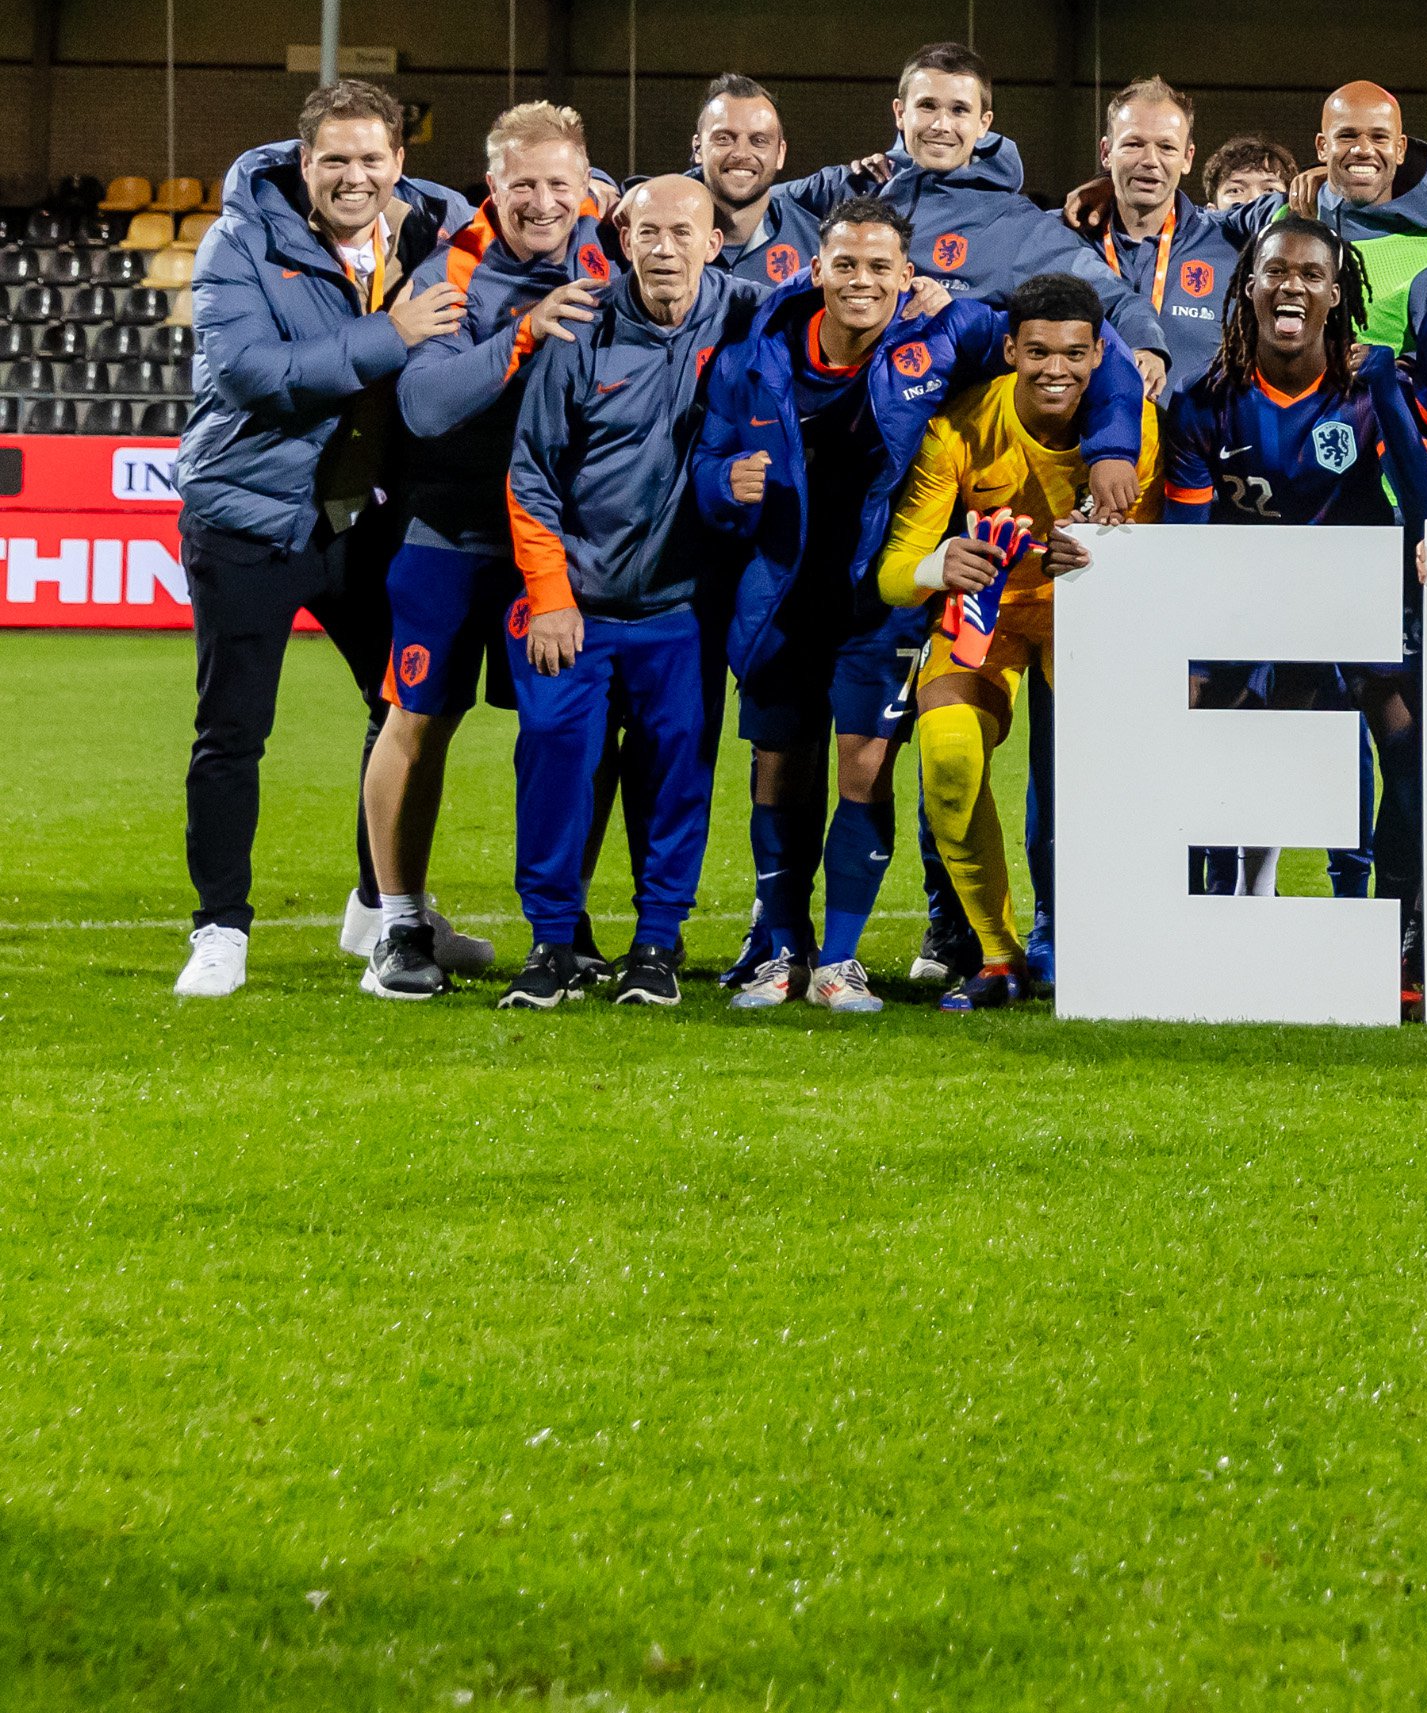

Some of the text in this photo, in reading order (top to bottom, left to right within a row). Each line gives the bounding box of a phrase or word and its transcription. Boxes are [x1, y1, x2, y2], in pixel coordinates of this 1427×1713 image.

[1172, 305, 1199, 318] ING
[902, 384, 925, 401] ING
[1222, 474, 1282, 518] 22
[0, 537, 192, 605] HIN
[896, 648, 921, 702] 7
